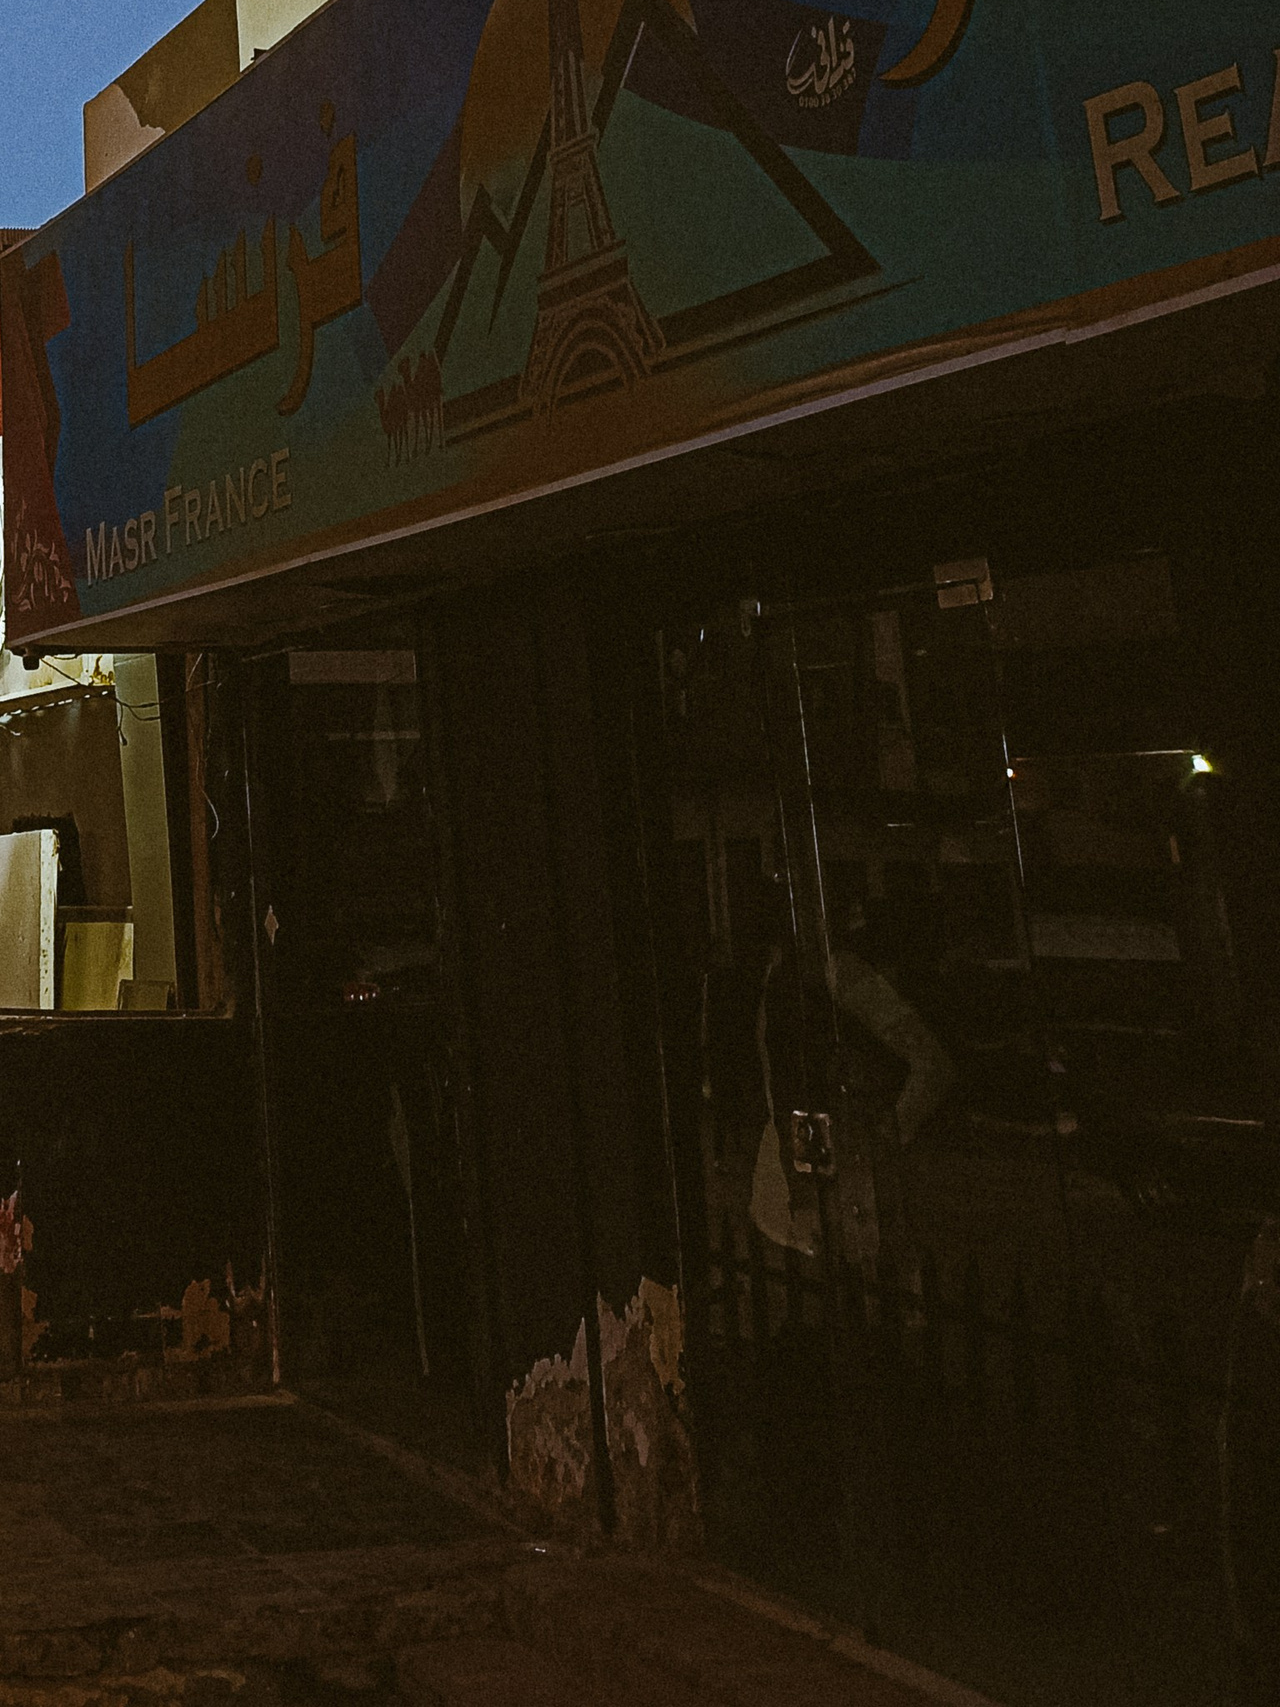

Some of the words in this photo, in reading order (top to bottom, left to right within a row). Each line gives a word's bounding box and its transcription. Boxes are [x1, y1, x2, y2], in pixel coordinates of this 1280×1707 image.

[1082, 48, 1280, 222] RE
[124, 97, 361, 429] فرنسا
[164, 447, 292, 554] FRANCE
